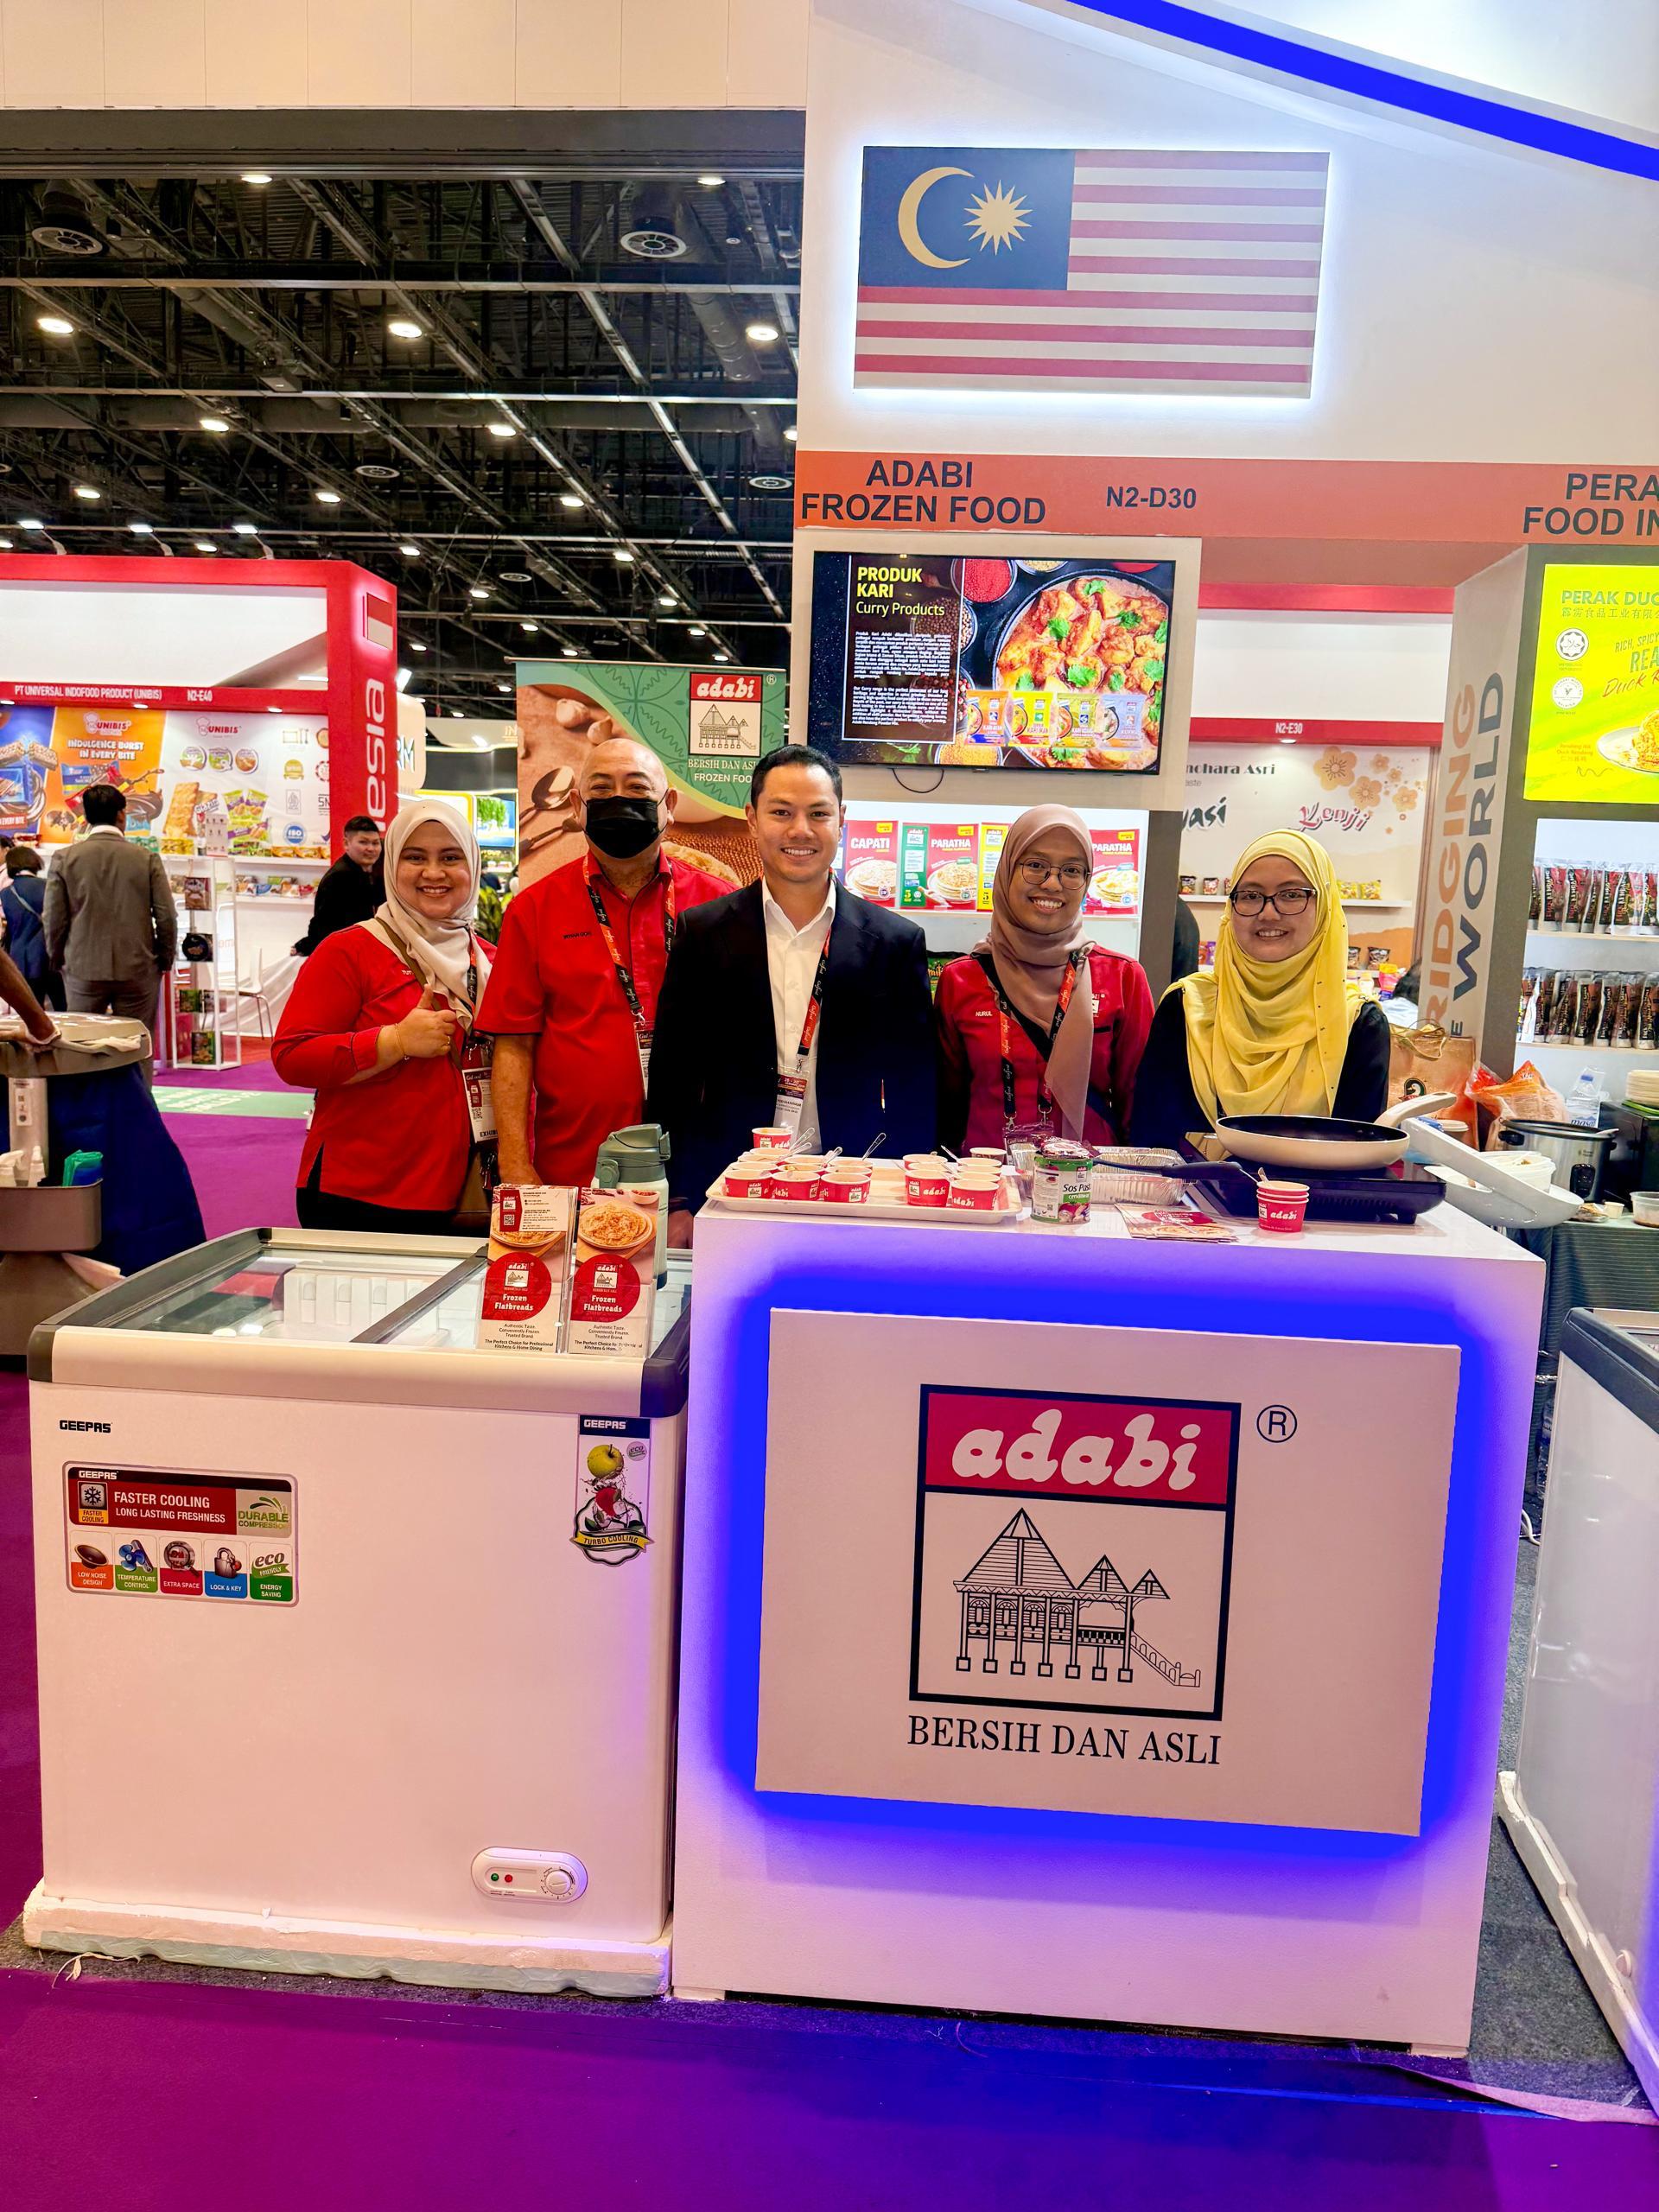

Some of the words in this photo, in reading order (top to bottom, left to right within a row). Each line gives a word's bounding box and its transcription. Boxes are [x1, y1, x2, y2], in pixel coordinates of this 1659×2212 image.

[866, 461, 973, 488] ADABI
[1566, 474, 1659, 501] PERA
[1106, 486, 1197, 509] N2-D30
[801, 493, 937, 523] FROZEN
[950, 496, 1046, 524] FOOD
[1522, 506, 1624, 536] FOOD
[857, 567, 923, 582] PRODUK
[856, 583, 894, 598] KARI
[1561, 590, 1619, 606] PERAK
[855, 601, 889, 618] Curry
[892, 603, 945, 616] Products
[15, 684, 25, 696] PT
[25, 685, 64, 696] UNIVERSAL
[65, 686, 100, 697] INDOFOOD
[101, 688, 133, 699] PRODUCT
[134, 689, 162, 700] (UNIBIS)
[696, 677, 755, 699] adabi
[187, 690, 213, 702] N2-E40
[1274, 721, 1303, 734] N2-E30
[67, 739, 117, 749] INDULGENCE
[117, 741, 144, 751] BURST
[79, 749, 89, 759] IN
[91, 750, 117, 760] EVERY
[118, 751, 136, 760] BITE
[688, 759, 720, 770] BERSIH
[721, 760, 741, 770] DAN
[1246, 764, 1275, 776] Asri
[694, 772, 731, 783] FROZEN
[1452, 672, 1503, 1001] WORLD
[850, 837, 890, 849] CAPATI
[931, 839, 971, 848] PARATHA
[1092, 842, 1132, 852] PARATHA
[923, 1185, 946, 1196] adabi
[1063, 1183, 1077, 1192] Sos
[1270, 1210, 1298, 1221] adabi
[508, 1262, 528, 1271] adabi
[596, 1264, 616, 1273] adabi
[502, 1294, 528, 1302] Frozen
[591, 1294, 616, 1304] Frozen
[494, 1302, 534, 1312] Flatbreads
[583, 1303, 623, 1313] Flatbreads
[59, 1420, 111, 1433] GEEPAS
[583, 1419, 626, 1430] GEEPAS
[951, 1408, 1201, 1491] adabi
[78, 1470, 118, 1480] GEEPAS
[114, 1491, 156, 1506] FASTER
[160, 1494, 210, 1509] COOLING
[115, 1507, 139, 1517] LONG
[139, 1509, 175, 1520] LASTING
[176, 1510, 226, 1523] FRESHNESS
[238, 1510, 289, 1523] DURABLE
[238, 1520, 289, 1529] COMPRESSOR
[583, 1535, 607, 1545] TURBO
[607, 1535, 639, 1544] COOLING
[254, 1552, 285, 1568] eco
[117, 1573, 156, 1583] TEMPERATURE
[259, 1567, 282, 1577] FRIENDLY
[124, 1580, 150, 1590] CONTROL
[259, 1583, 283, 1592] ENERGY
[260, 1590, 282, 1599] SAVING
[907, 1715, 1041, 1753] BERSIH
[1051, 1725, 1129, 1759] DAN
[1138, 1731, 1222, 1765] ASLI
